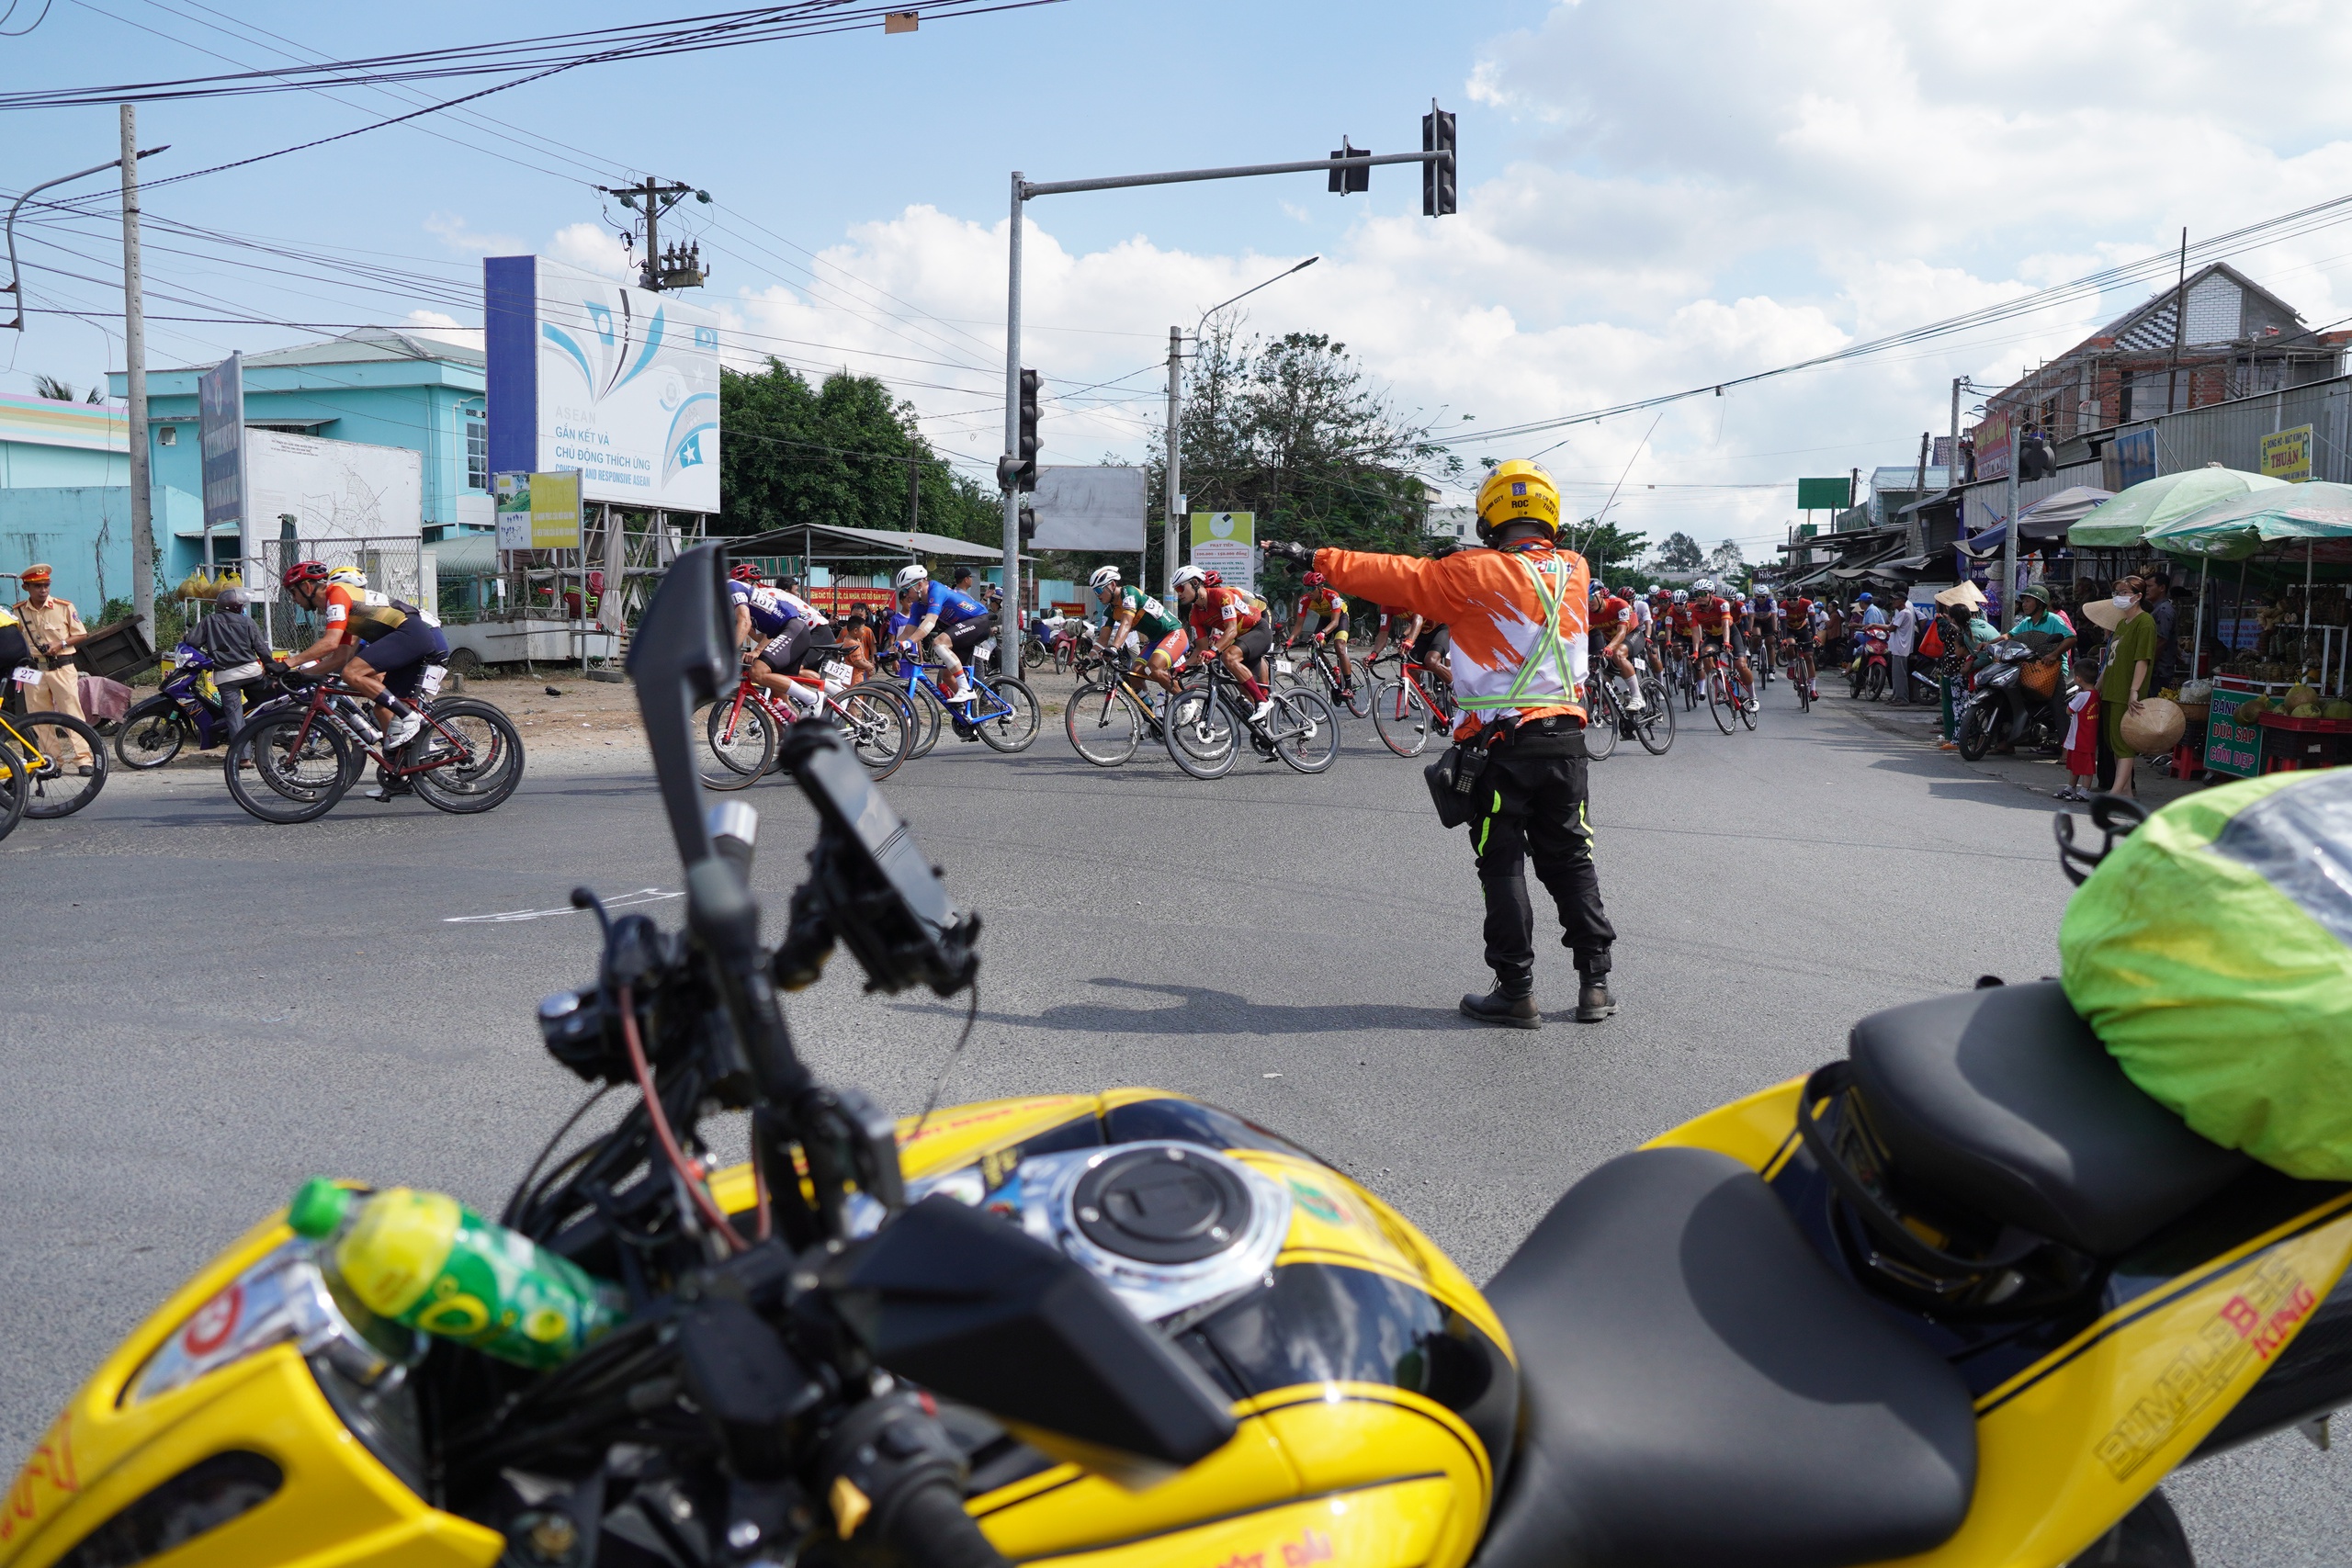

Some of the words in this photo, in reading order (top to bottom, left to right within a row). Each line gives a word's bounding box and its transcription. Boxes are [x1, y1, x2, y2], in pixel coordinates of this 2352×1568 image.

[555, 405, 596, 424] ASEAN
[555, 423, 576, 440] GẮN
[578, 427, 596, 443] KẾT
[597, 431, 610, 446] VÀ
[555, 445, 575, 459] CHỦ
[577, 447, 604, 465] ĐỘNG
[605, 453, 631, 468] THÍCH
[632, 456, 650, 470] ỨNG
[2270, 446, 2300, 469] THUẬN
[584, 468, 597, 480] AND
[597, 469, 632, 485] RESPONSIVE
[632, 474, 650, 487] ASEAN
[369, 592, 379, 603] 7
[1224, 608, 1233, 616] 81
[763, 634, 787, 653] KERN
[772, 637, 792, 656] PHARMA
[975, 648, 989, 658] 117
[20, 669, 35, 680] 27
[829, 663, 845, 676] 137
[2209, 742, 2232, 764] CỐM
[2233, 750, 2256, 771] DẸP
[2252, 1279, 2316, 1362] KING
